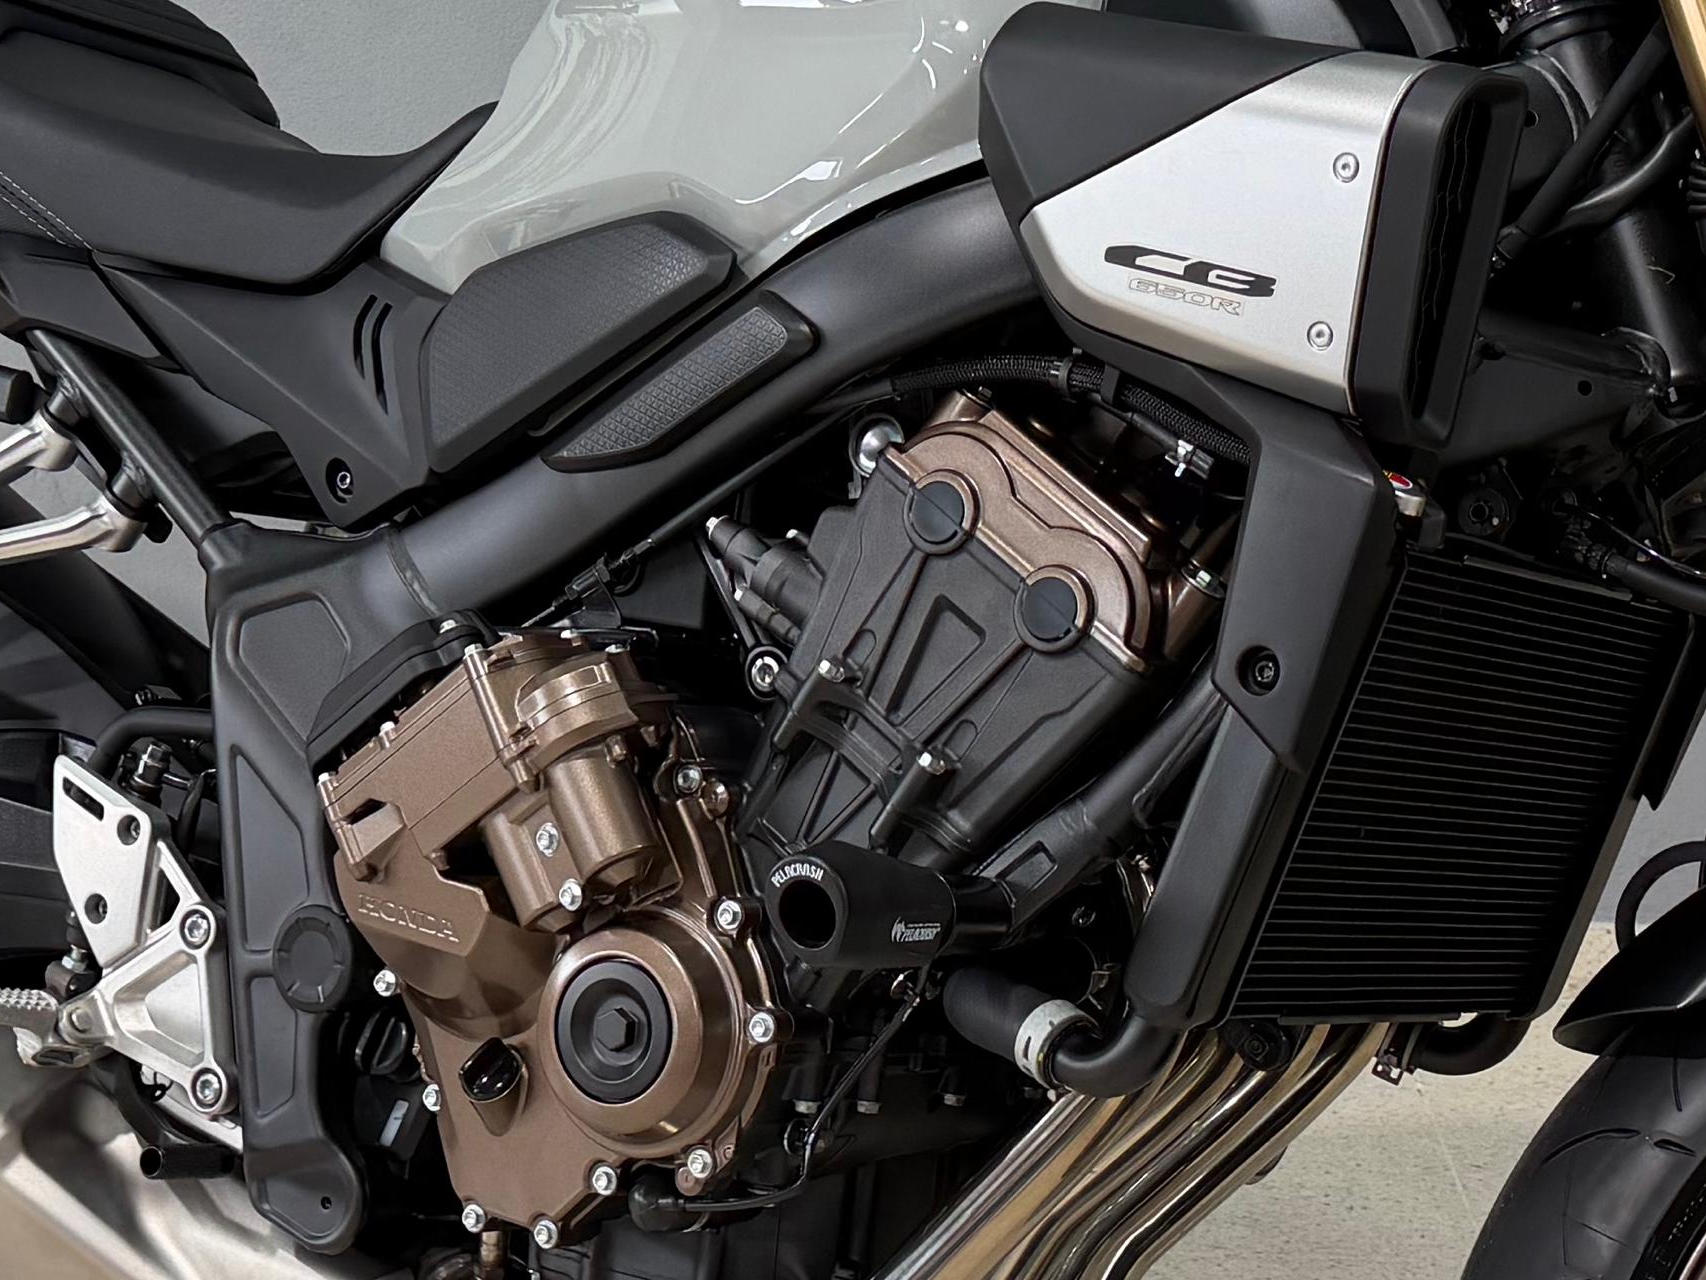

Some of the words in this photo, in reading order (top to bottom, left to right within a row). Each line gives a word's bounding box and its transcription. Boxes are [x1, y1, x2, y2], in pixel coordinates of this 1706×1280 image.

[1104, 244, 1278, 298] CB
[1128, 277, 1241, 317] 650R
[357, 893, 461, 943] HONDA
